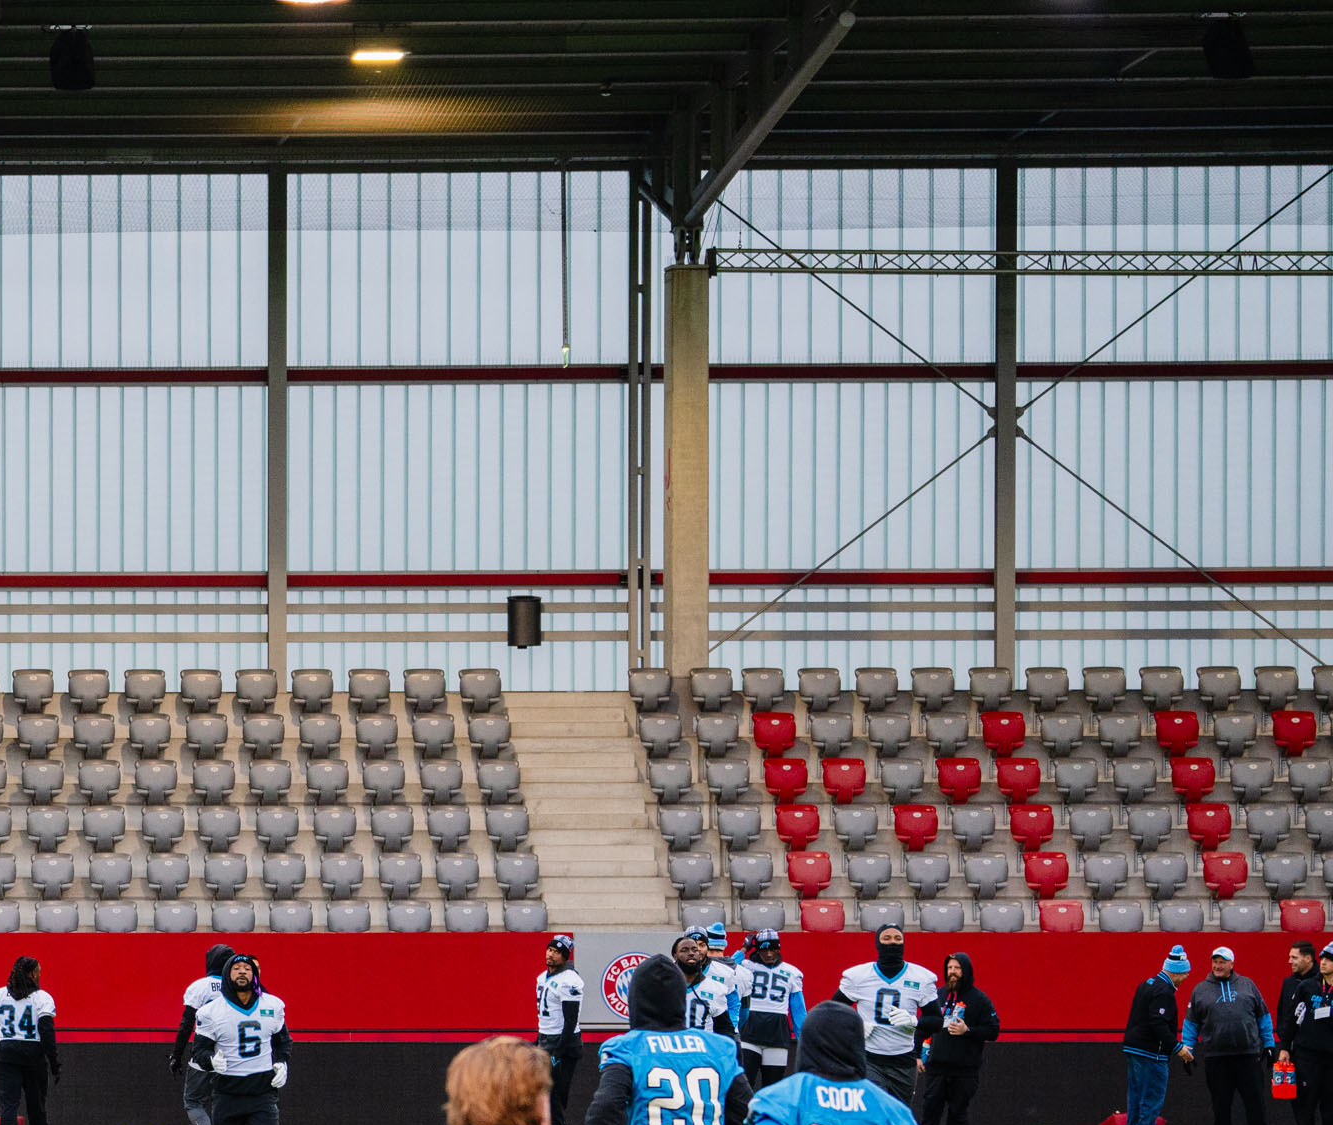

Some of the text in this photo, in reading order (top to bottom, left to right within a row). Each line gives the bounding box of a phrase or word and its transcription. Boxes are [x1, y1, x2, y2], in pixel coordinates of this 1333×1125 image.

[607, 966, 620, 982] FC
[754, 970, 789, 1003] 85
[0, 1004, 36, 1039] 34
[238, 1020, 261, 1059] 6
[647, 1035, 707, 1054] FULLER
[816, 1085, 867, 1112] COOK
